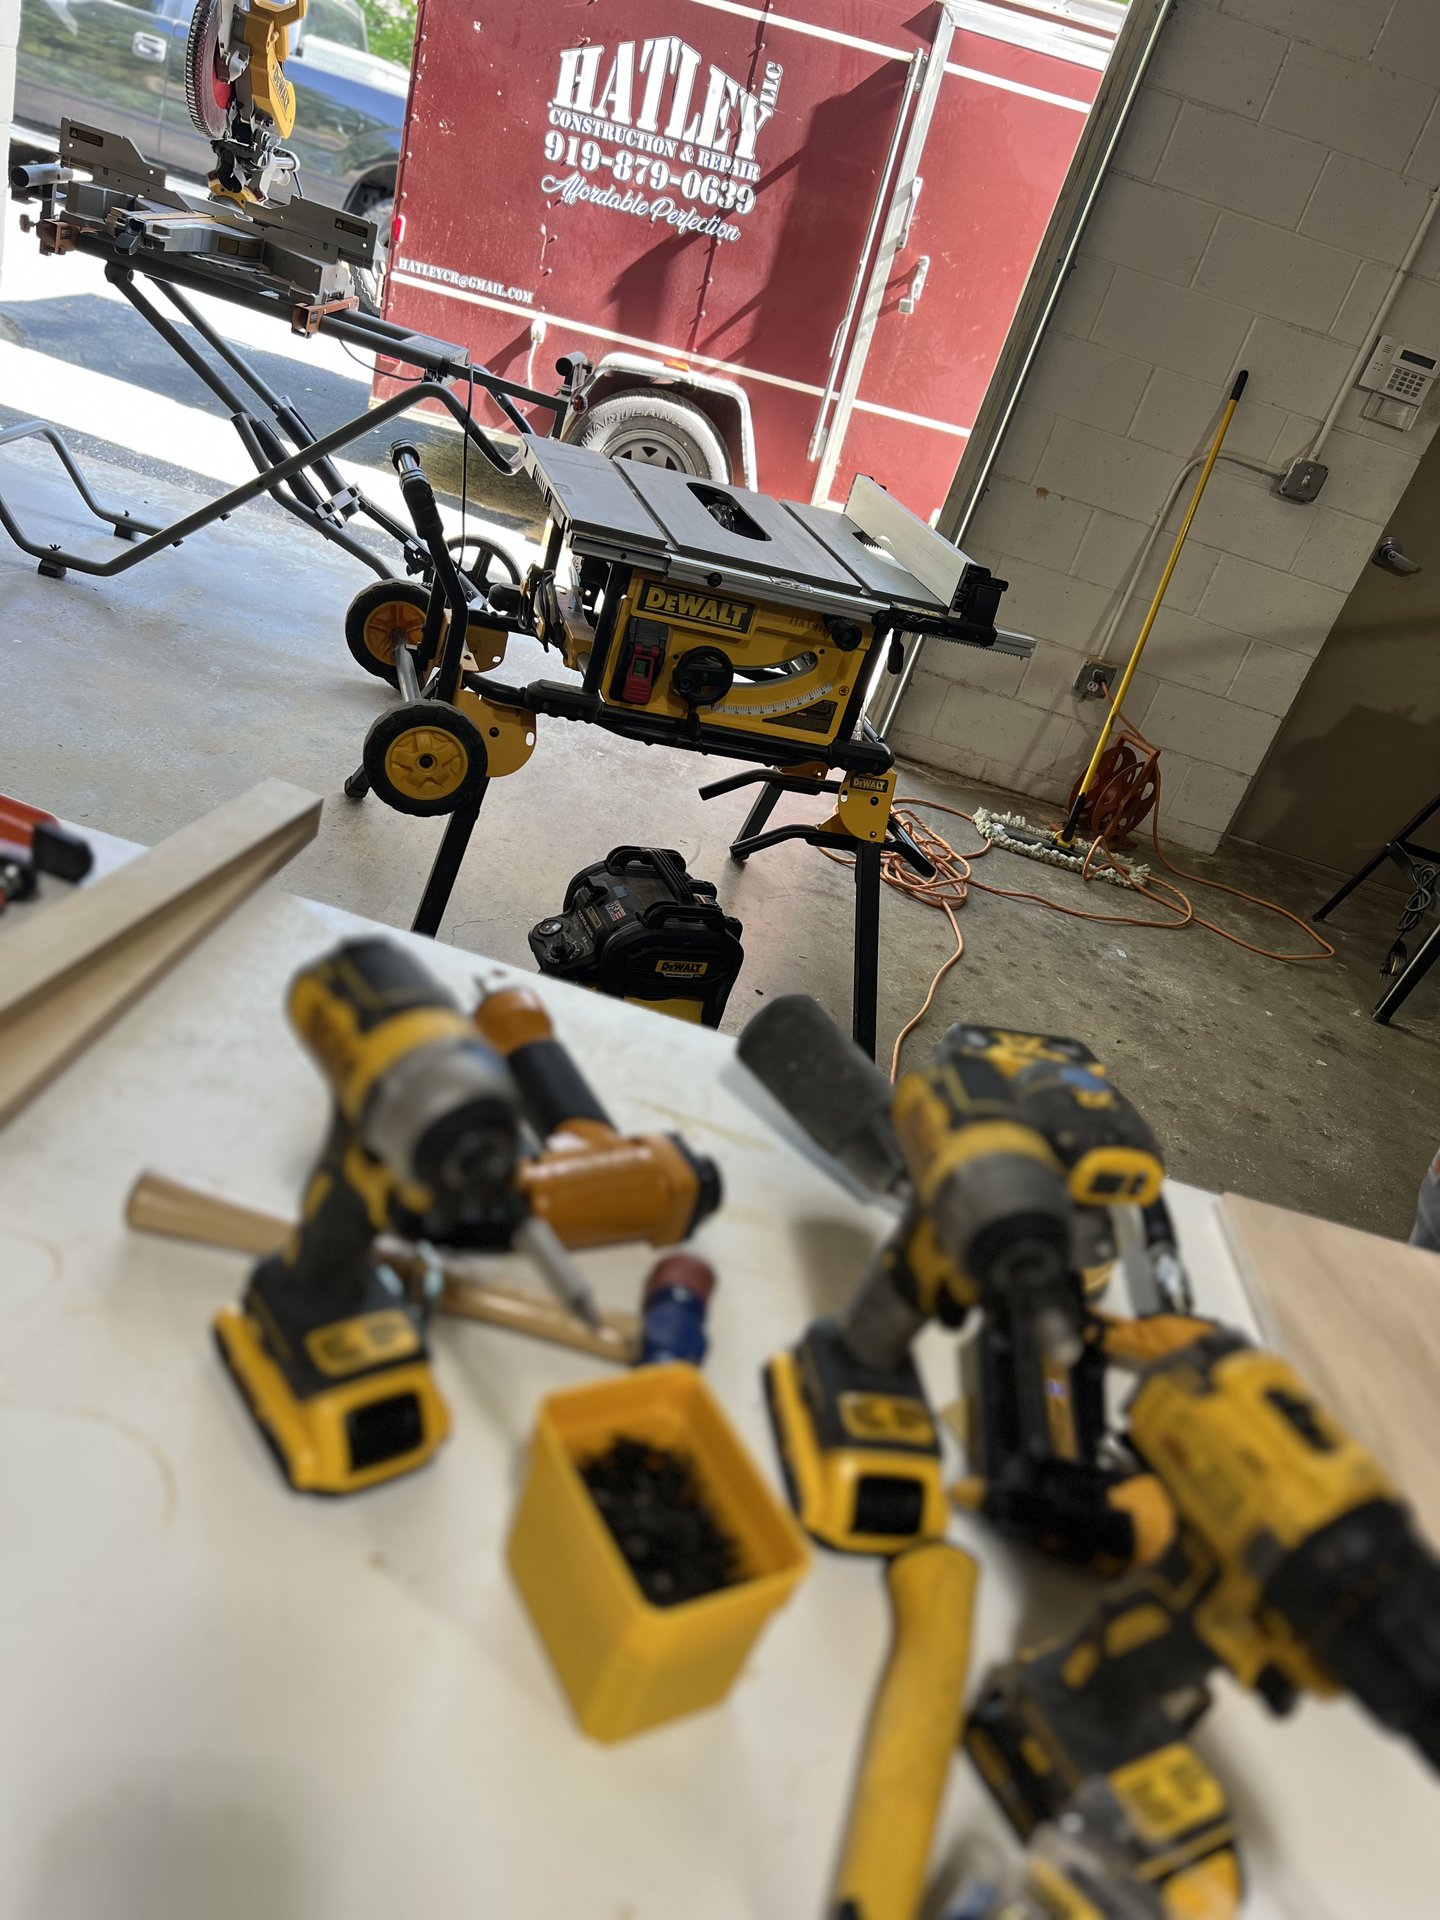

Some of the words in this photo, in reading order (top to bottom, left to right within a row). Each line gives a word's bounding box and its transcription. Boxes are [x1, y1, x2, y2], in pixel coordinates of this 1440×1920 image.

[551, 35, 774, 160] HATLEY
[759, 61, 783, 107] LLC
[549, 108, 678, 160] CONSTRUCTION
[678, 144, 695, 164] &
[697, 149, 761, 182] REPAIR
[544, 129, 757, 215] 919-879-0639
[541, 170, 651, 217] Affordable
[649, 197, 742, 242] Perfection
[398, 256, 534, 304] HATLEYCR@GMAIL.COM
[644, 586, 749, 627] DEWALT
[853, 777, 886, 790] DEWALT
[661, 961, 704, 973] DEWALT
